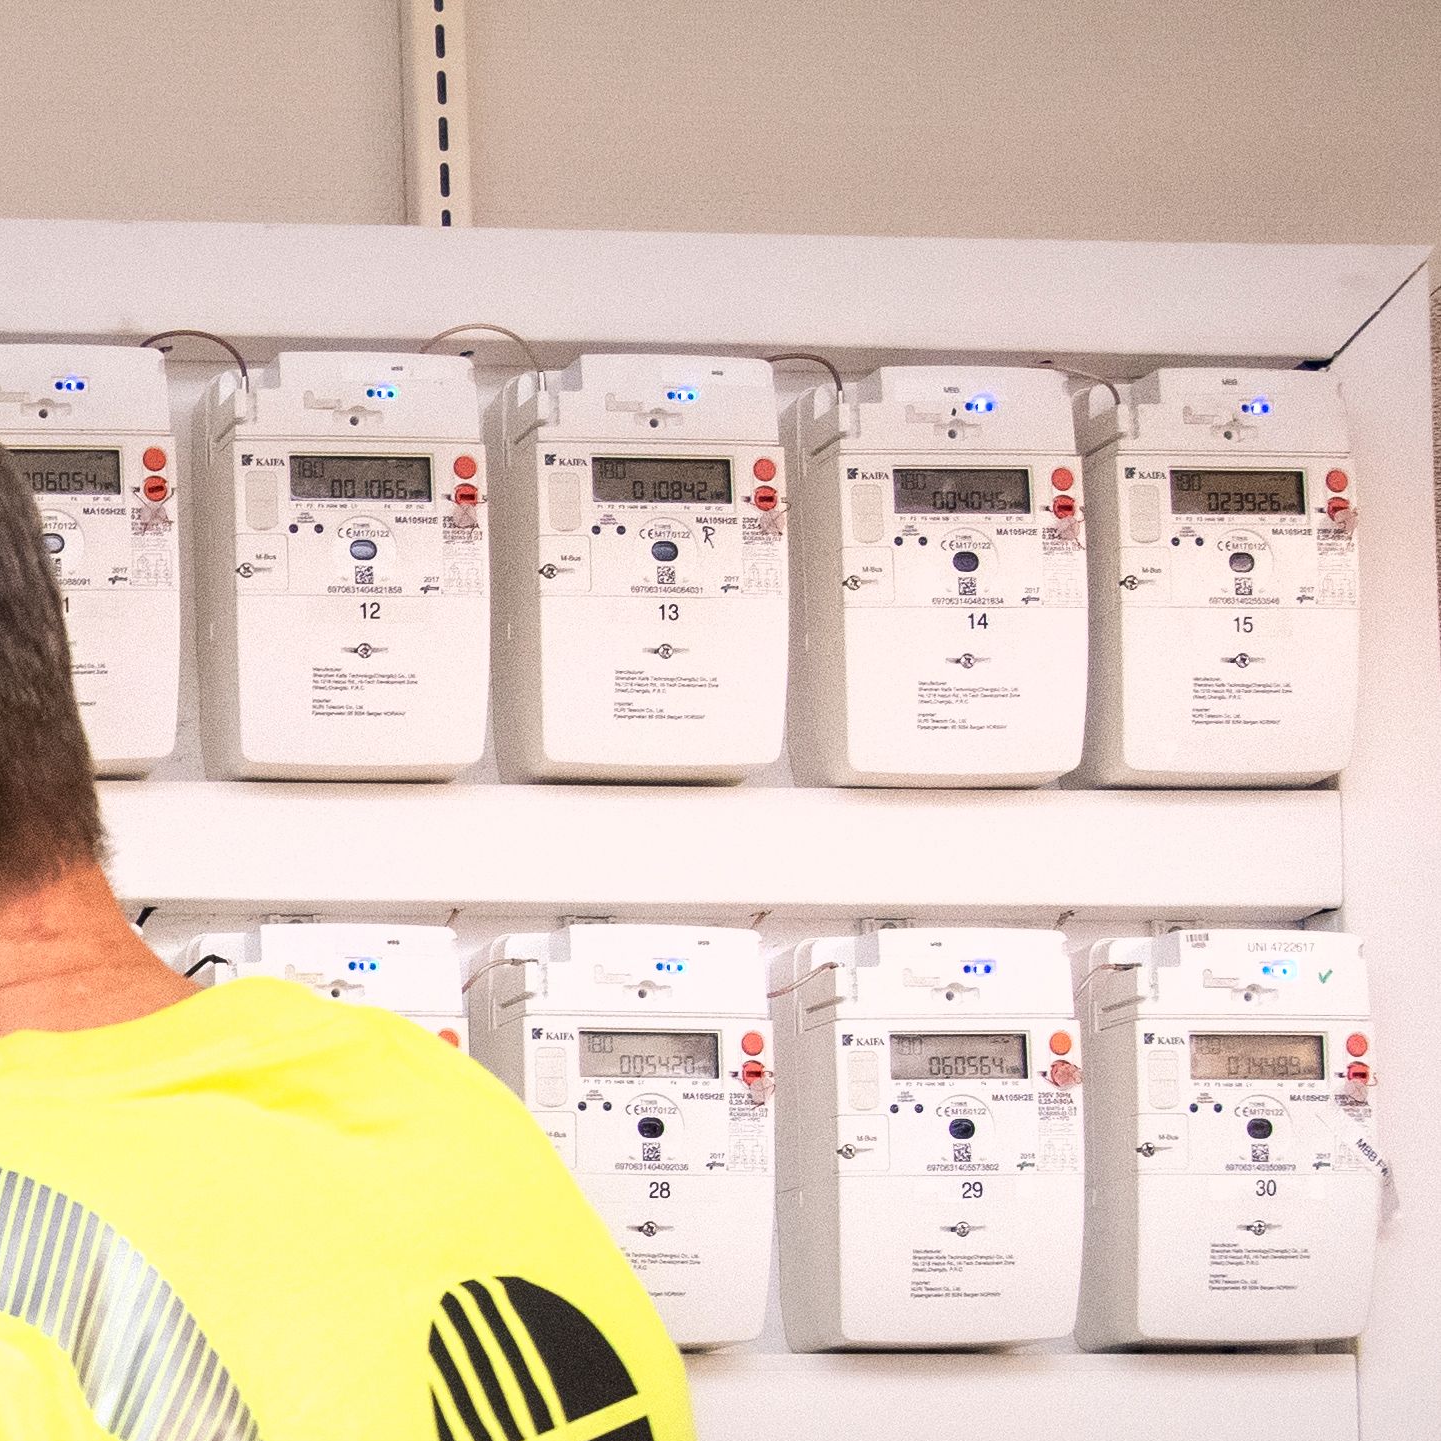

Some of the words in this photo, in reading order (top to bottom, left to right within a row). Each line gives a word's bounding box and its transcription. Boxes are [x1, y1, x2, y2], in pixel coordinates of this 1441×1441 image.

[256, 458, 285, 466] KAIFA
[559, 458, 587, 466] KAIFA
[861, 472, 889, 480] KAIFA
[1139, 471, 1166, 479] KAIFA
[633, 481, 707, 499] 010842
[360, 602, 380, 619] 12
[659, 604, 679, 621] 13
[969, 613, 988, 629] 14
[1234, 616, 1253, 633] 15
[546, 1032, 574, 1040] KAIFA
[856, 1038, 884, 1046] KAIFA
[1158, 1037, 1185, 1045] KAIFA
[620, 1055, 695, 1074] 005420
[929, 1057, 1004, 1075] 060564
[1356, 1139, 1377, 1162] MBB
[649, 1182, 670, 1199] 28
[962, 1181, 983, 1199] 29
[1256, 1179, 1277, 1197] 30
